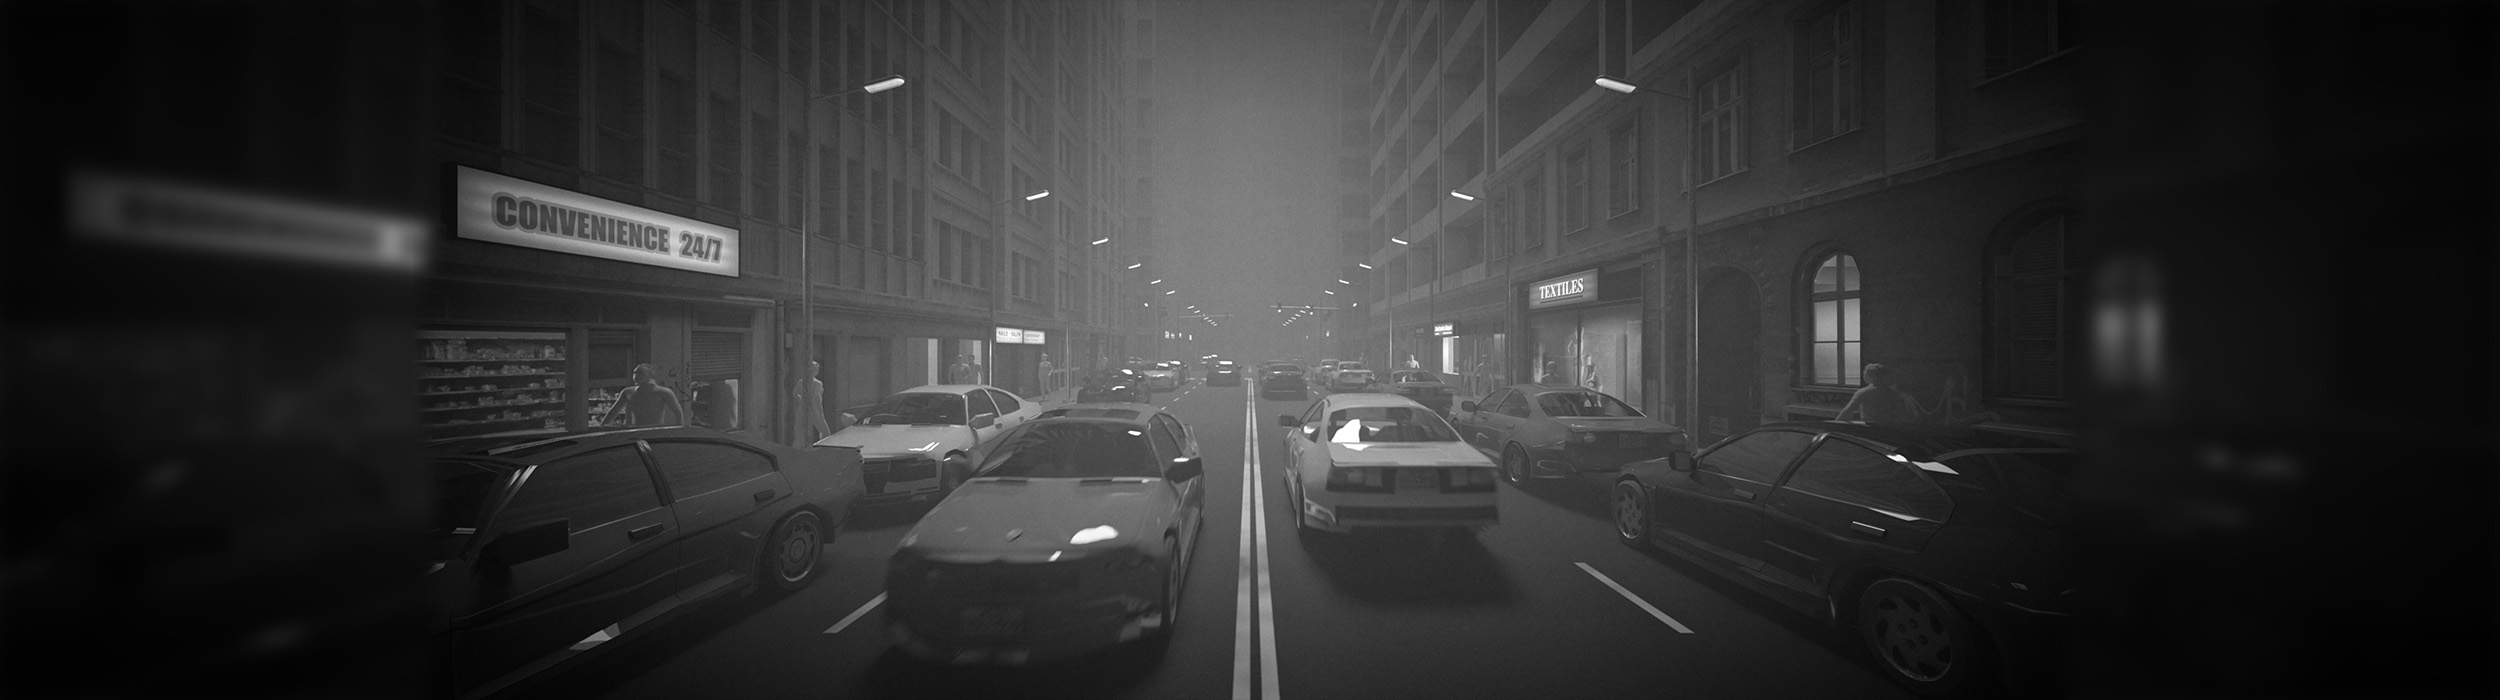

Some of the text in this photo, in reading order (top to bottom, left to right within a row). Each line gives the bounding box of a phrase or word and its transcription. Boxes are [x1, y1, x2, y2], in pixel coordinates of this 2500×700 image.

[493, 193, 722, 263] CONVENIENCE 24/7
[1539, 277, 1584, 300] TEXTILES
